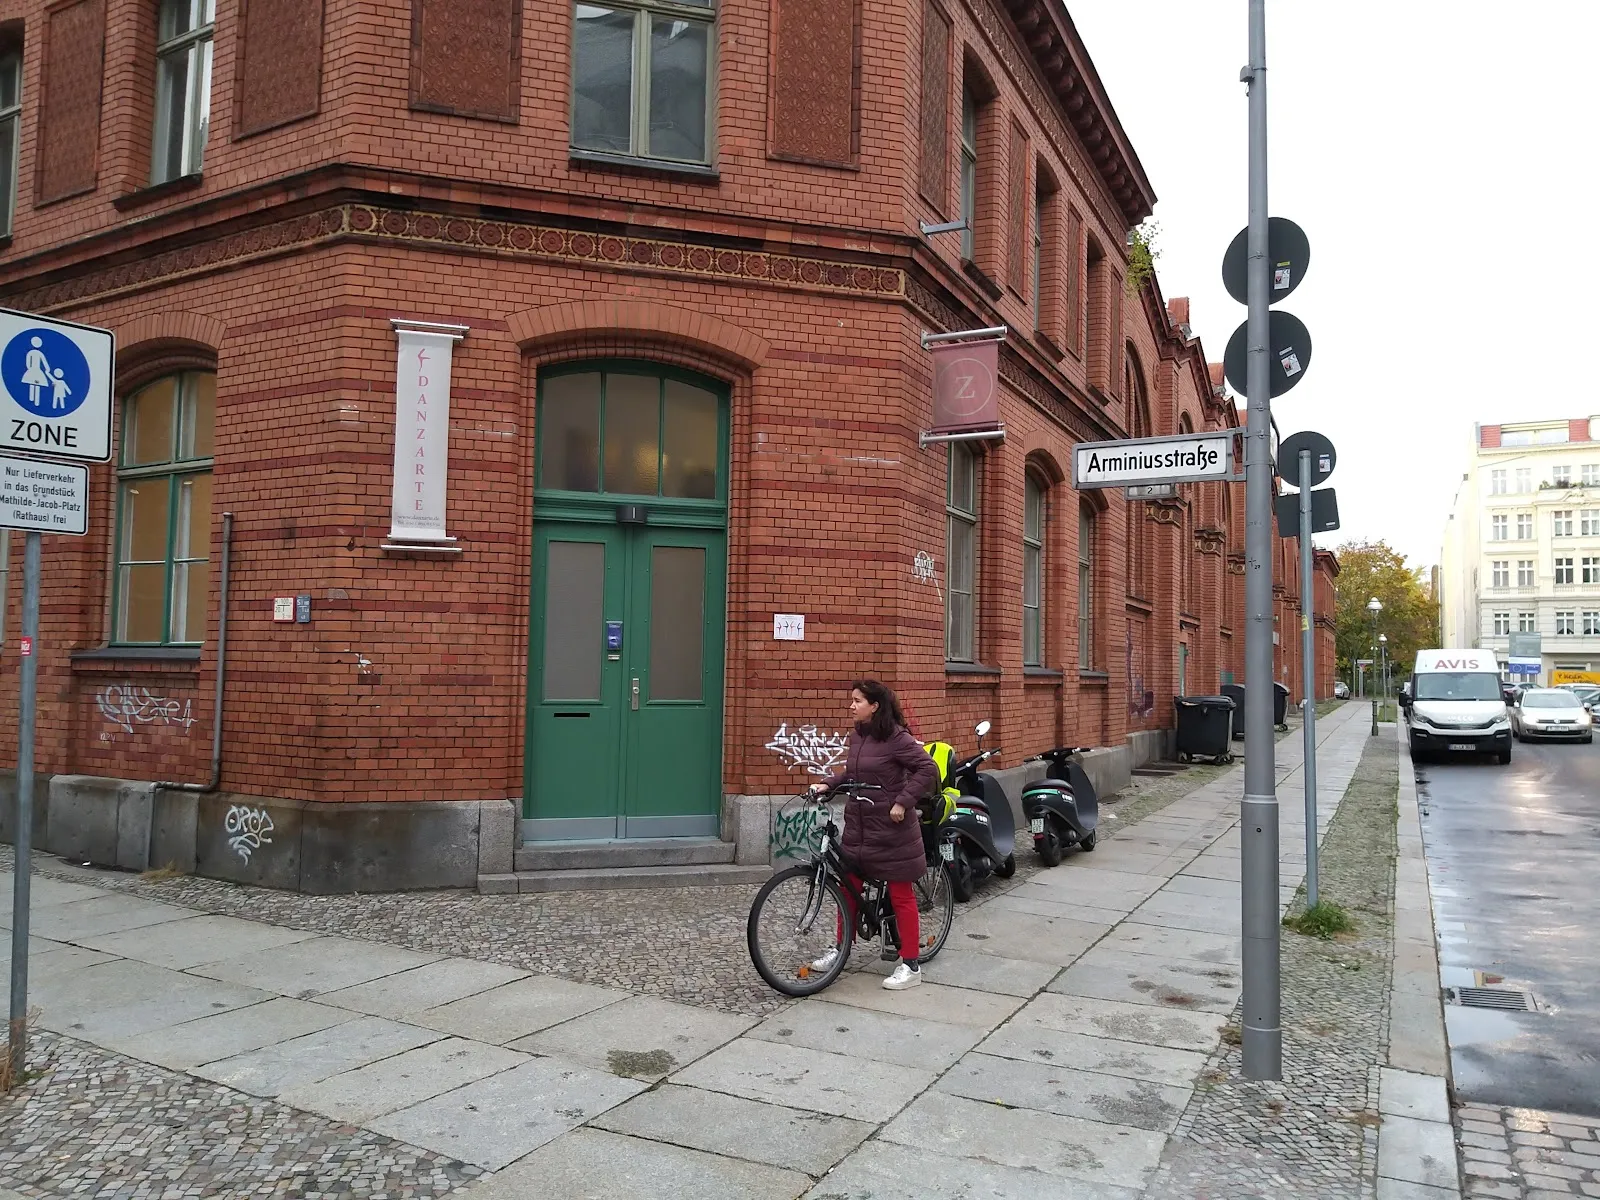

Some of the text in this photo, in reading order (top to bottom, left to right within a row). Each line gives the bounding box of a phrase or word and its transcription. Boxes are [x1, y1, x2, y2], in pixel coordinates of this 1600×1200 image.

[954, 375, 976, 399] Z
[11, 419, 78, 448] ZONE
[415, 375, 429, 511] DANZARTE
[1087, 445, 1218, 473] Arminiusstraße
[5, 466, 76, 484] Nur Lieferverkehr
[4, 481, 76, 498] in das Grundstück
[0, 495, 81, 512] Mathilde-Jacob-Platz
[13, 510, 67, 524] (Rathaus) frei
[1434, 659, 1480, 670] AVIS
